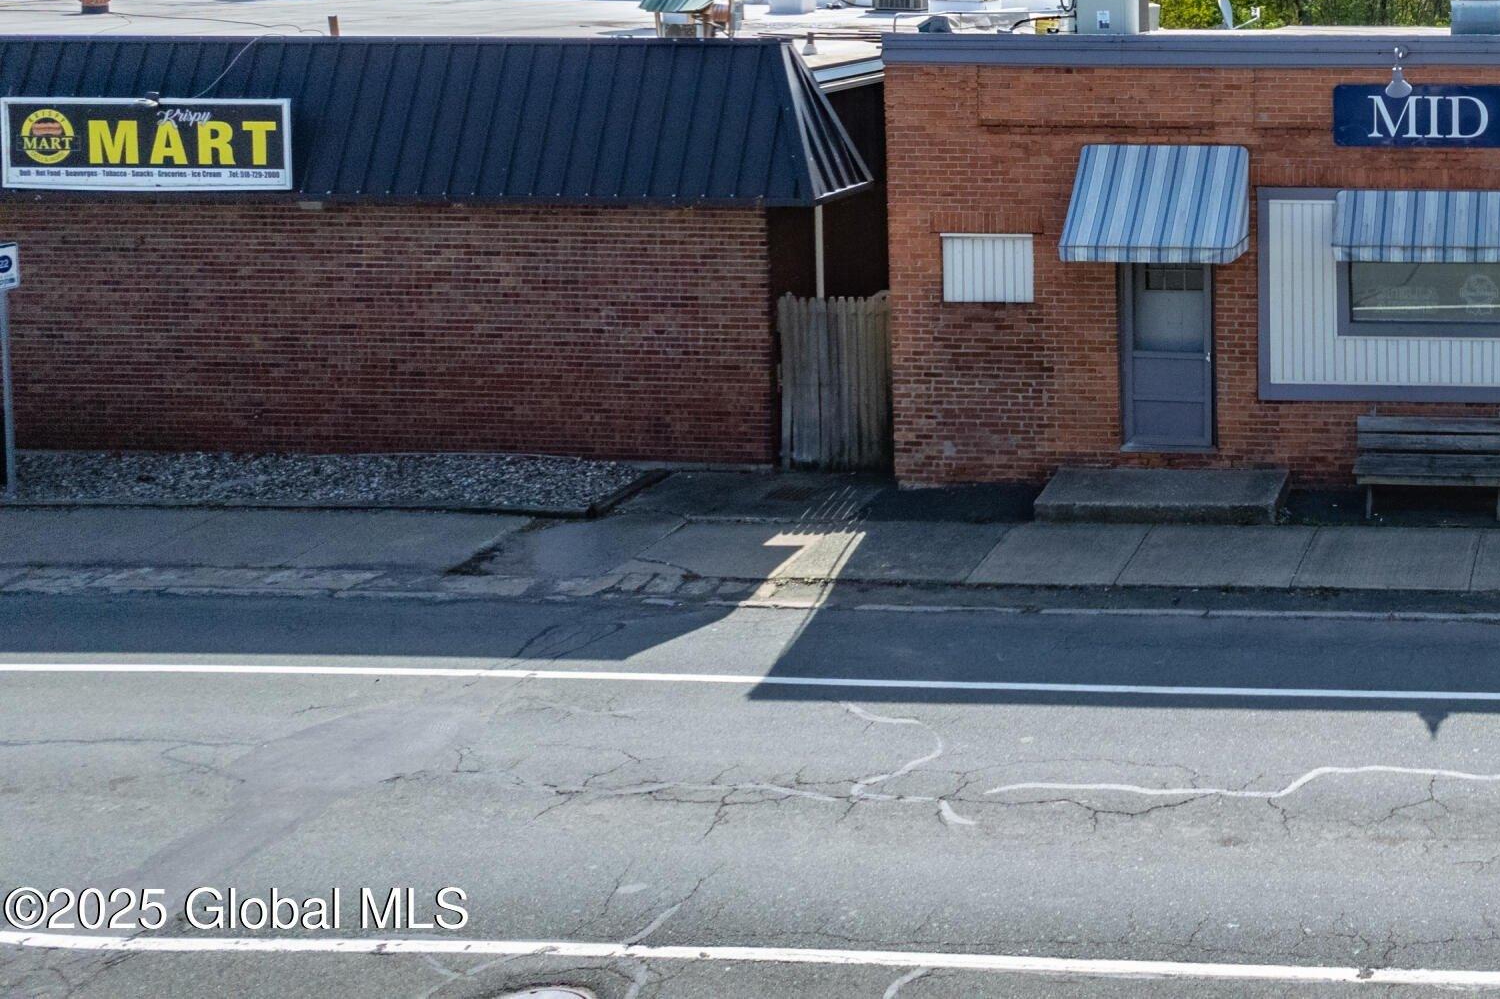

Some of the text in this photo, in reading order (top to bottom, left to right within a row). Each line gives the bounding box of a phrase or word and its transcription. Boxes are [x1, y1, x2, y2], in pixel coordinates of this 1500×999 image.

[156, 109, 212, 129] Krispy
[1367, 94, 1489, 139] MID
[23, 136, 73, 150] MART
[88, 119, 277, 165] MART
